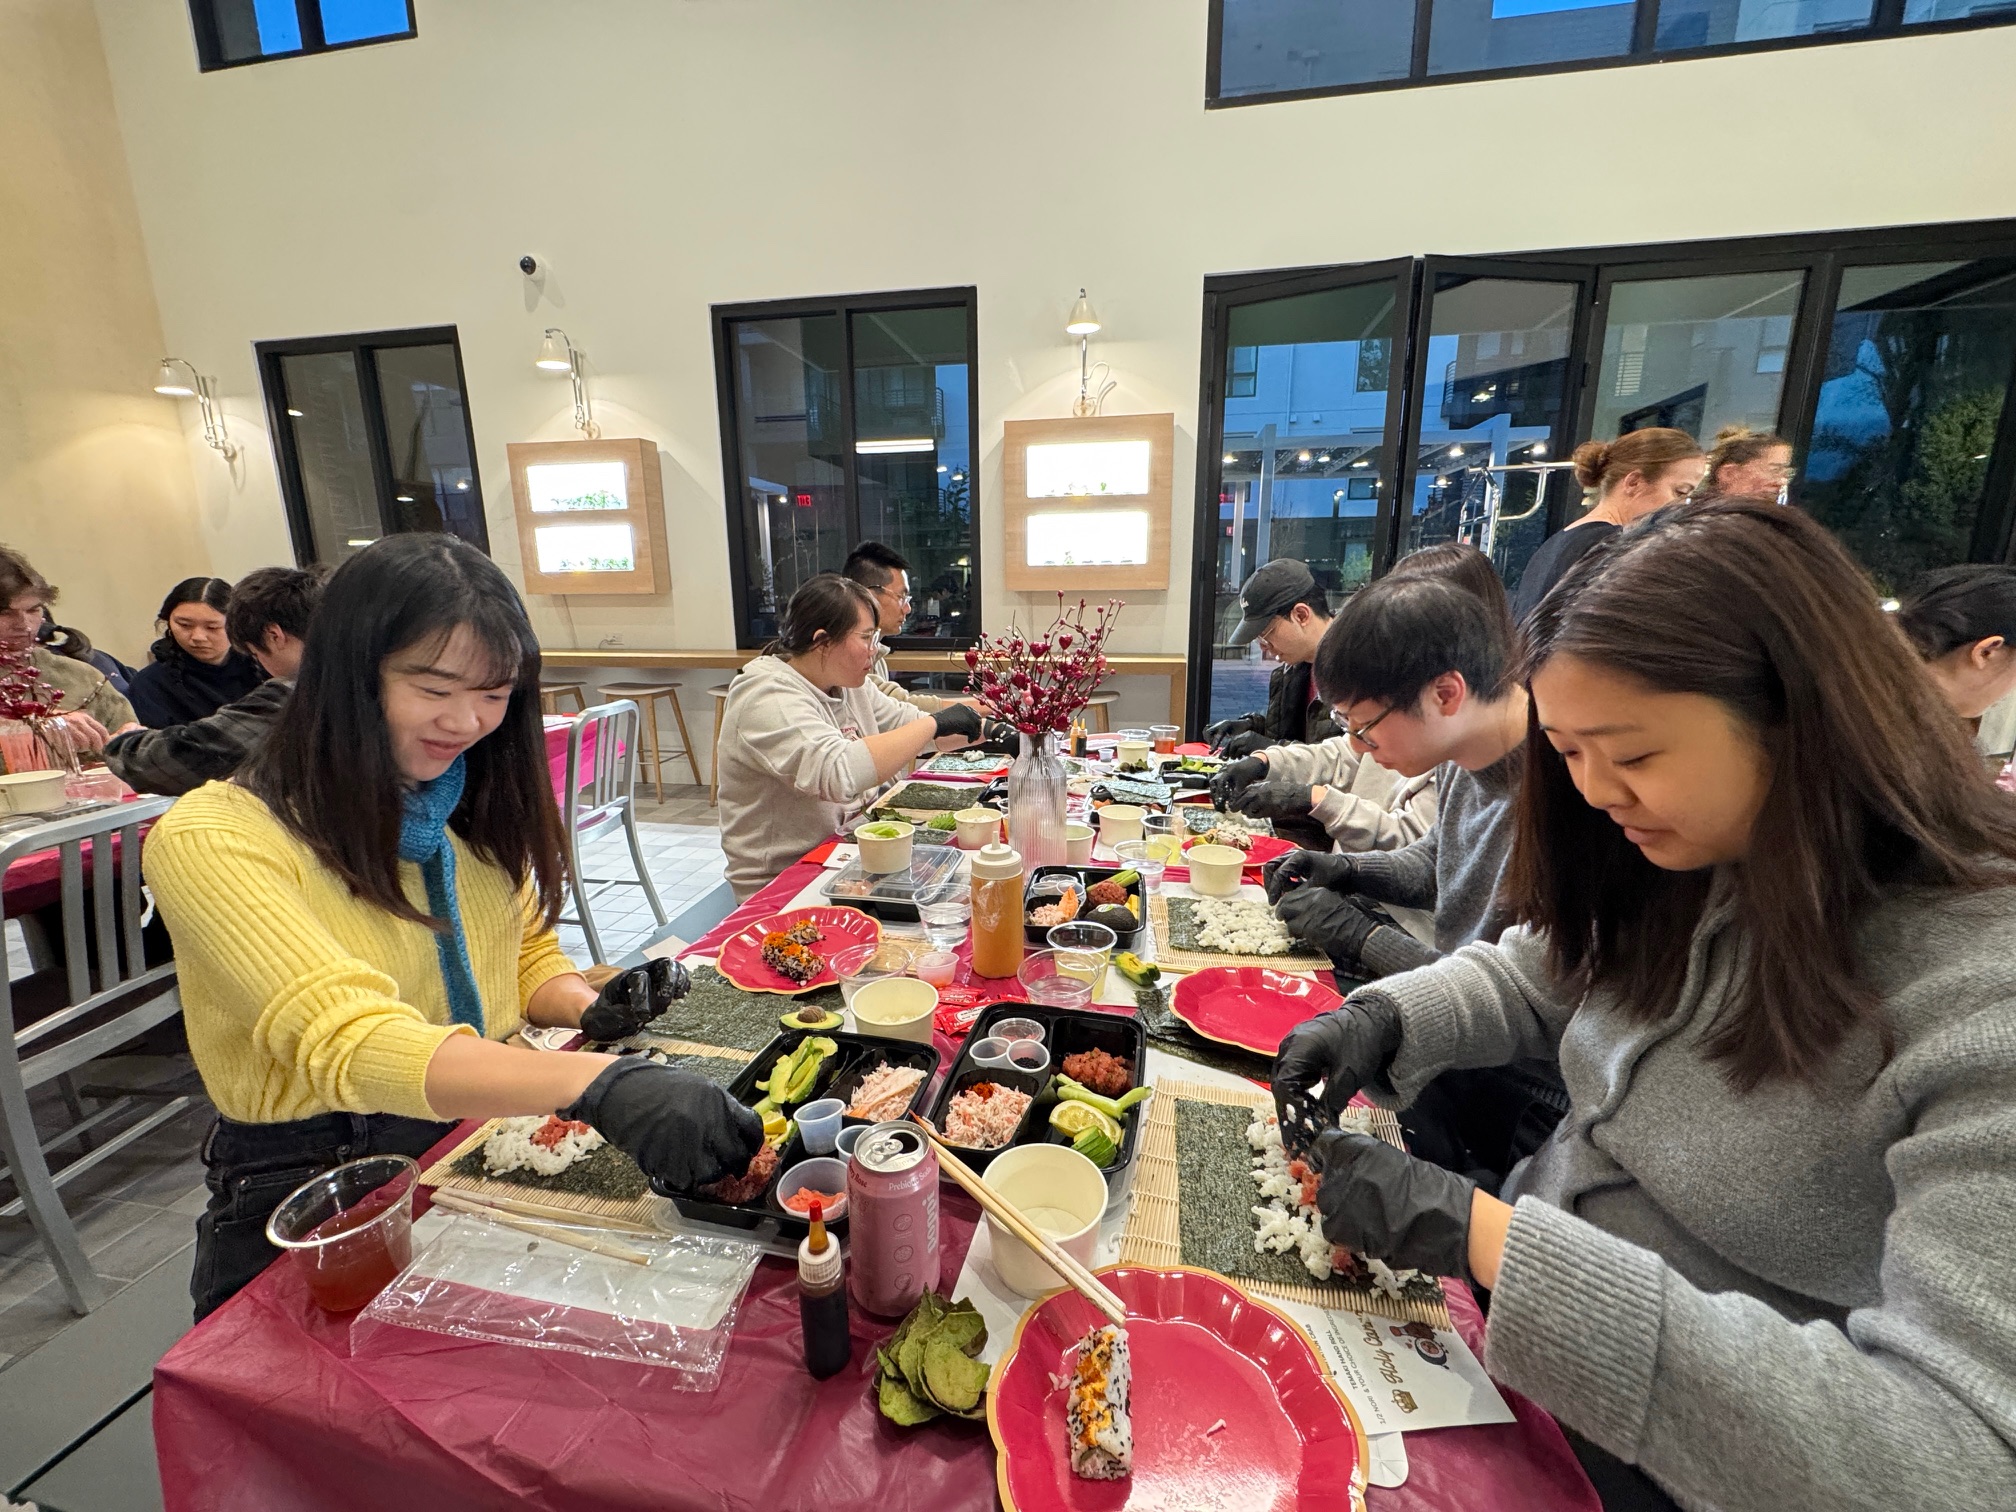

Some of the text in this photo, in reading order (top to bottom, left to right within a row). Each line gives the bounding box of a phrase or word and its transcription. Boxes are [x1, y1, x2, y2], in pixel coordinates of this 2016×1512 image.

[855, 1173, 868, 1188] Rose
[888, 1176, 919, 1191] Prebiotic
[1337, 1336, 1345, 1345] OF
[1325, 1330, 1359, 1390] TEMAKI HAND ROLL
[1341, 1345, 1357, 1369] CHOICE
[1373, 1348, 1404, 1384] Holy
[1354, 1369, 1367, 1388] YOUR
[1367, 1395, 1380, 1412] NORI
